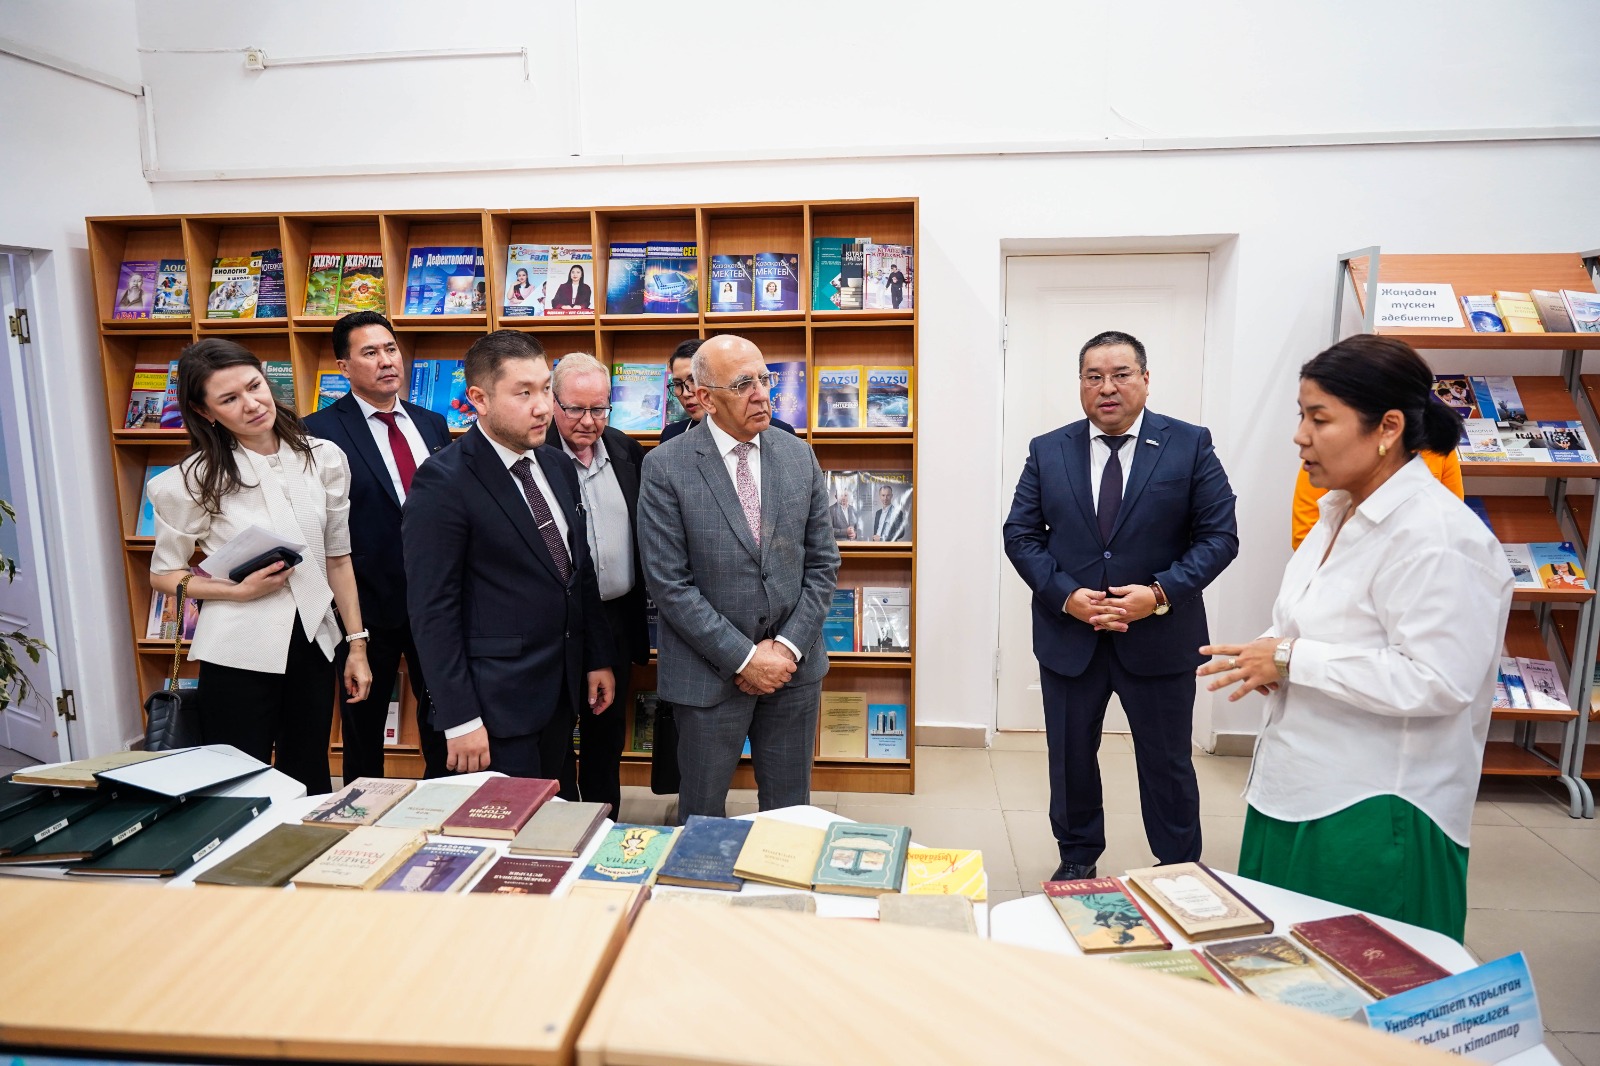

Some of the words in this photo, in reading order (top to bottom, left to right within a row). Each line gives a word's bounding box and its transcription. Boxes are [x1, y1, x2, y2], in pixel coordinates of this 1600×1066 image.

[426, 254, 474, 267] Дефектология
[1382, 289, 1437, 297] Жаңадан
[1381, 314, 1454, 322] әдебиеттер
[821, 376, 858, 384] QAZSU
[869, 376, 907, 384] QAZSU
[1051, 883, 1091, 891] ЗАРЕ
[1385, 999, 1466, 1034] Университет
[1468, 978, 1522, 1007] құрылған
[1452, 1004, 1510, 1035] тіркелген
[1464, 1023, 1519, 1053] кітаптар
